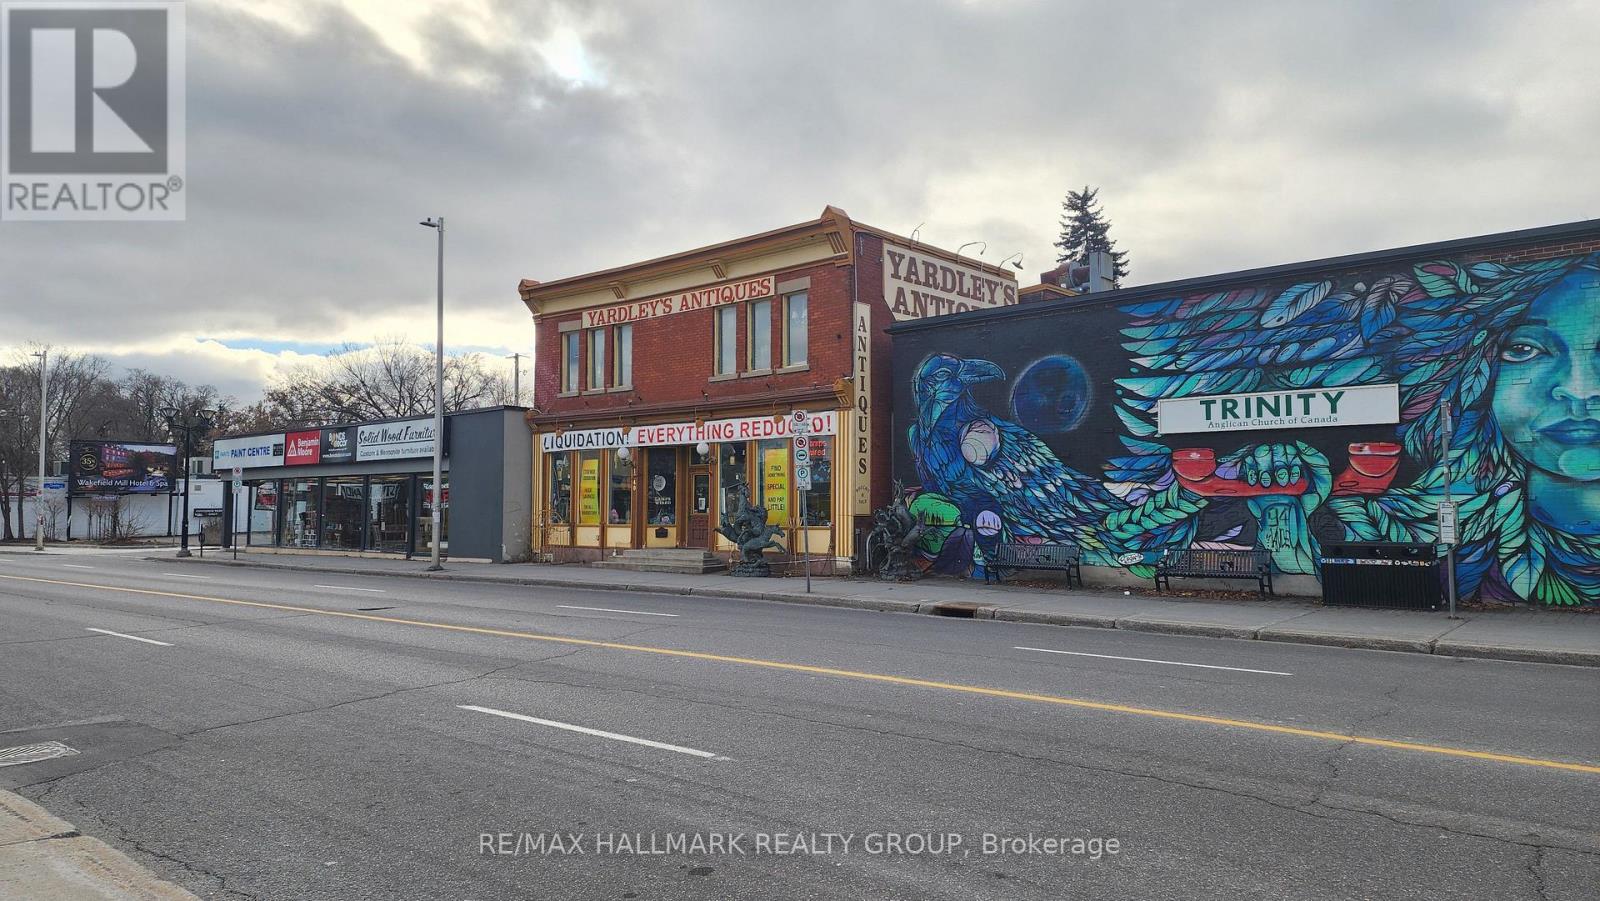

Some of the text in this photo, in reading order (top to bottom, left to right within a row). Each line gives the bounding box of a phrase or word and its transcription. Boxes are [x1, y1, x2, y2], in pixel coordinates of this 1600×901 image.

[887, 250, 1016, 305] YARDLEY'S
[587, 277, 771, 327] YARDLEY'S ANTIQUES
[857, 316, 868, 475] ANTIQUES
[1199, 391, 1345, 420] TRINITY
[1208, 415, 1338, 429] Anglican Church of Canada
[358, 430, 380, 444] Solid
[381, 428, 403, 442] Wood
[543, 431, 630, 450] LIQUIDATION!
[637, 423, 734, 445] EVERYTHING
[740, 415, 831, 438] REDUD!
[297, 438, 320, 447] Benjamin
[230, 448, 246, 458] PAINT
[247, 446, 271, 457] CENTRE
[297, 448, 313, 456] Moore
[129, 479, 149, 487] Hotel
